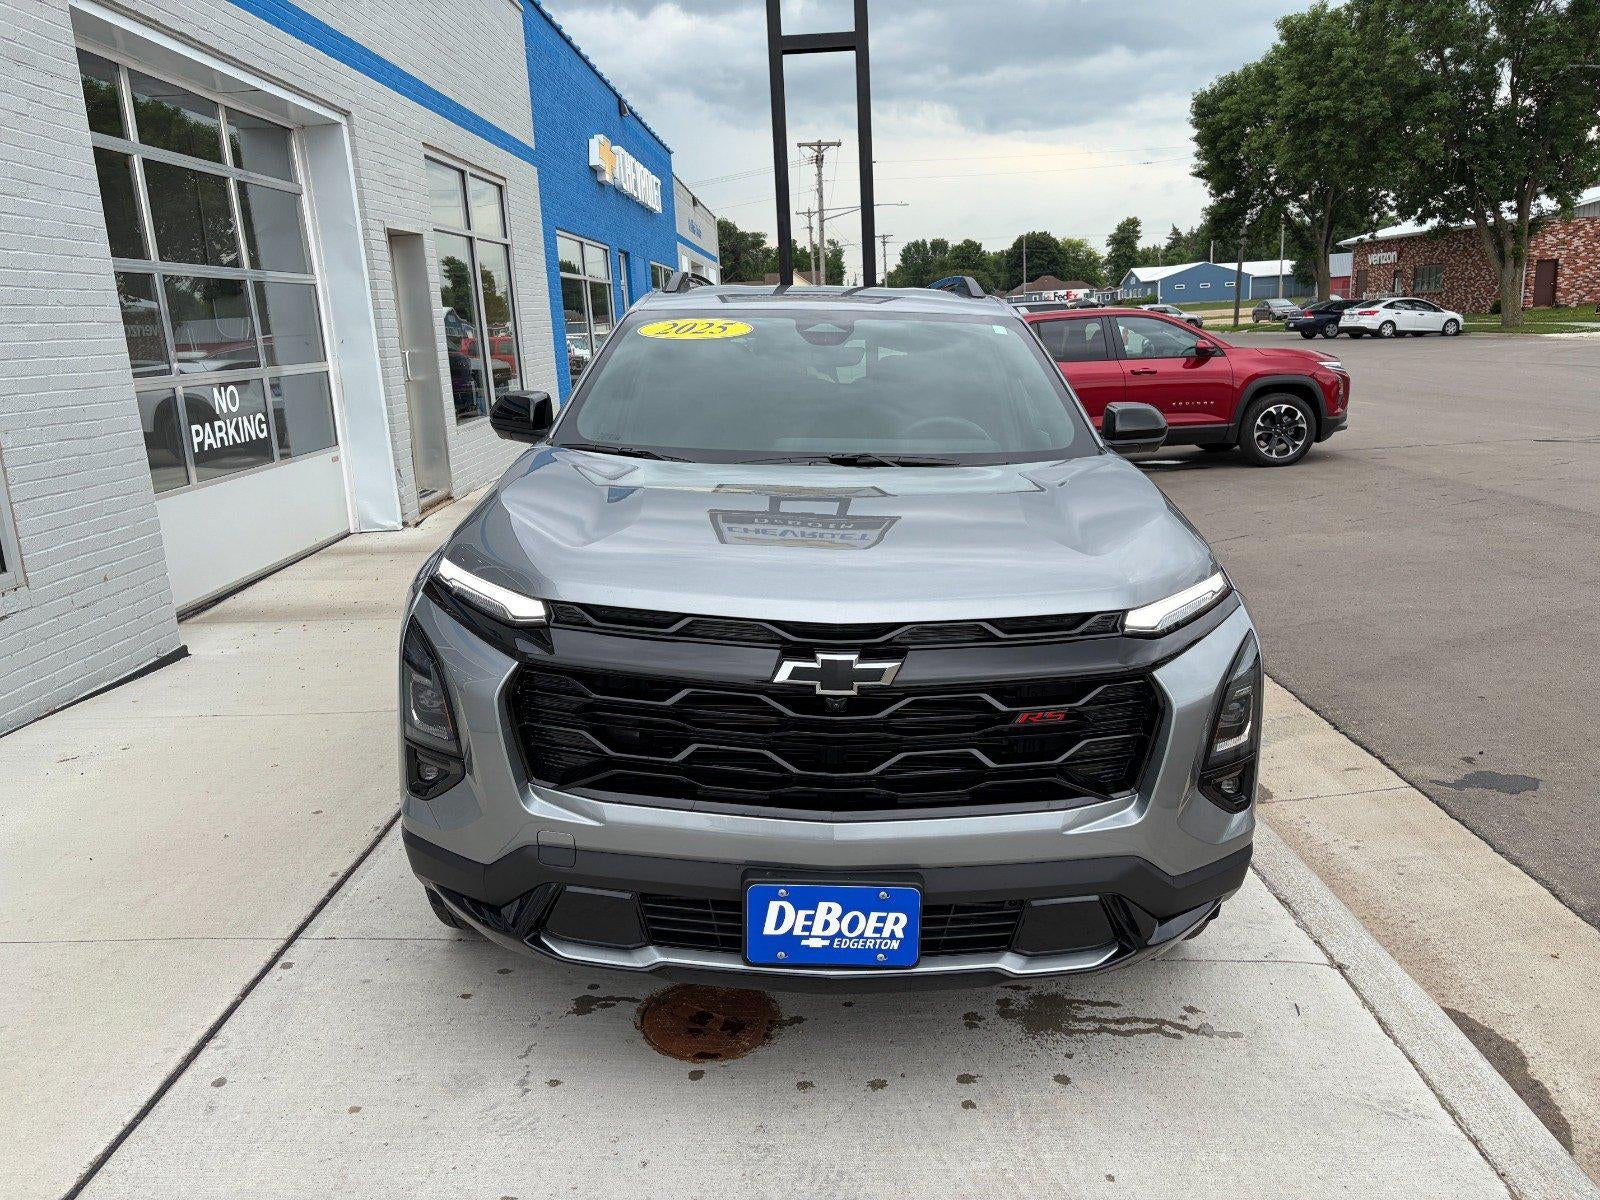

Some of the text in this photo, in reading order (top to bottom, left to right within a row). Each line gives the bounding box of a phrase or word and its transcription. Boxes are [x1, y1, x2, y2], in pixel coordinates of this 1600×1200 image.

[612, 146, 662, 213] CHEVROLET
[1368, 249, 1398, 265] verizon
[1053, 290, 1079, 301] FedEx
[655, 322, 735, 335] 2025
[212, 385, 240, 414] NO
[191, 412, 268, 452] PARKING
[1015, 711, 1066, 724] RS
[833, 937, 901, 950] EDGERTON
